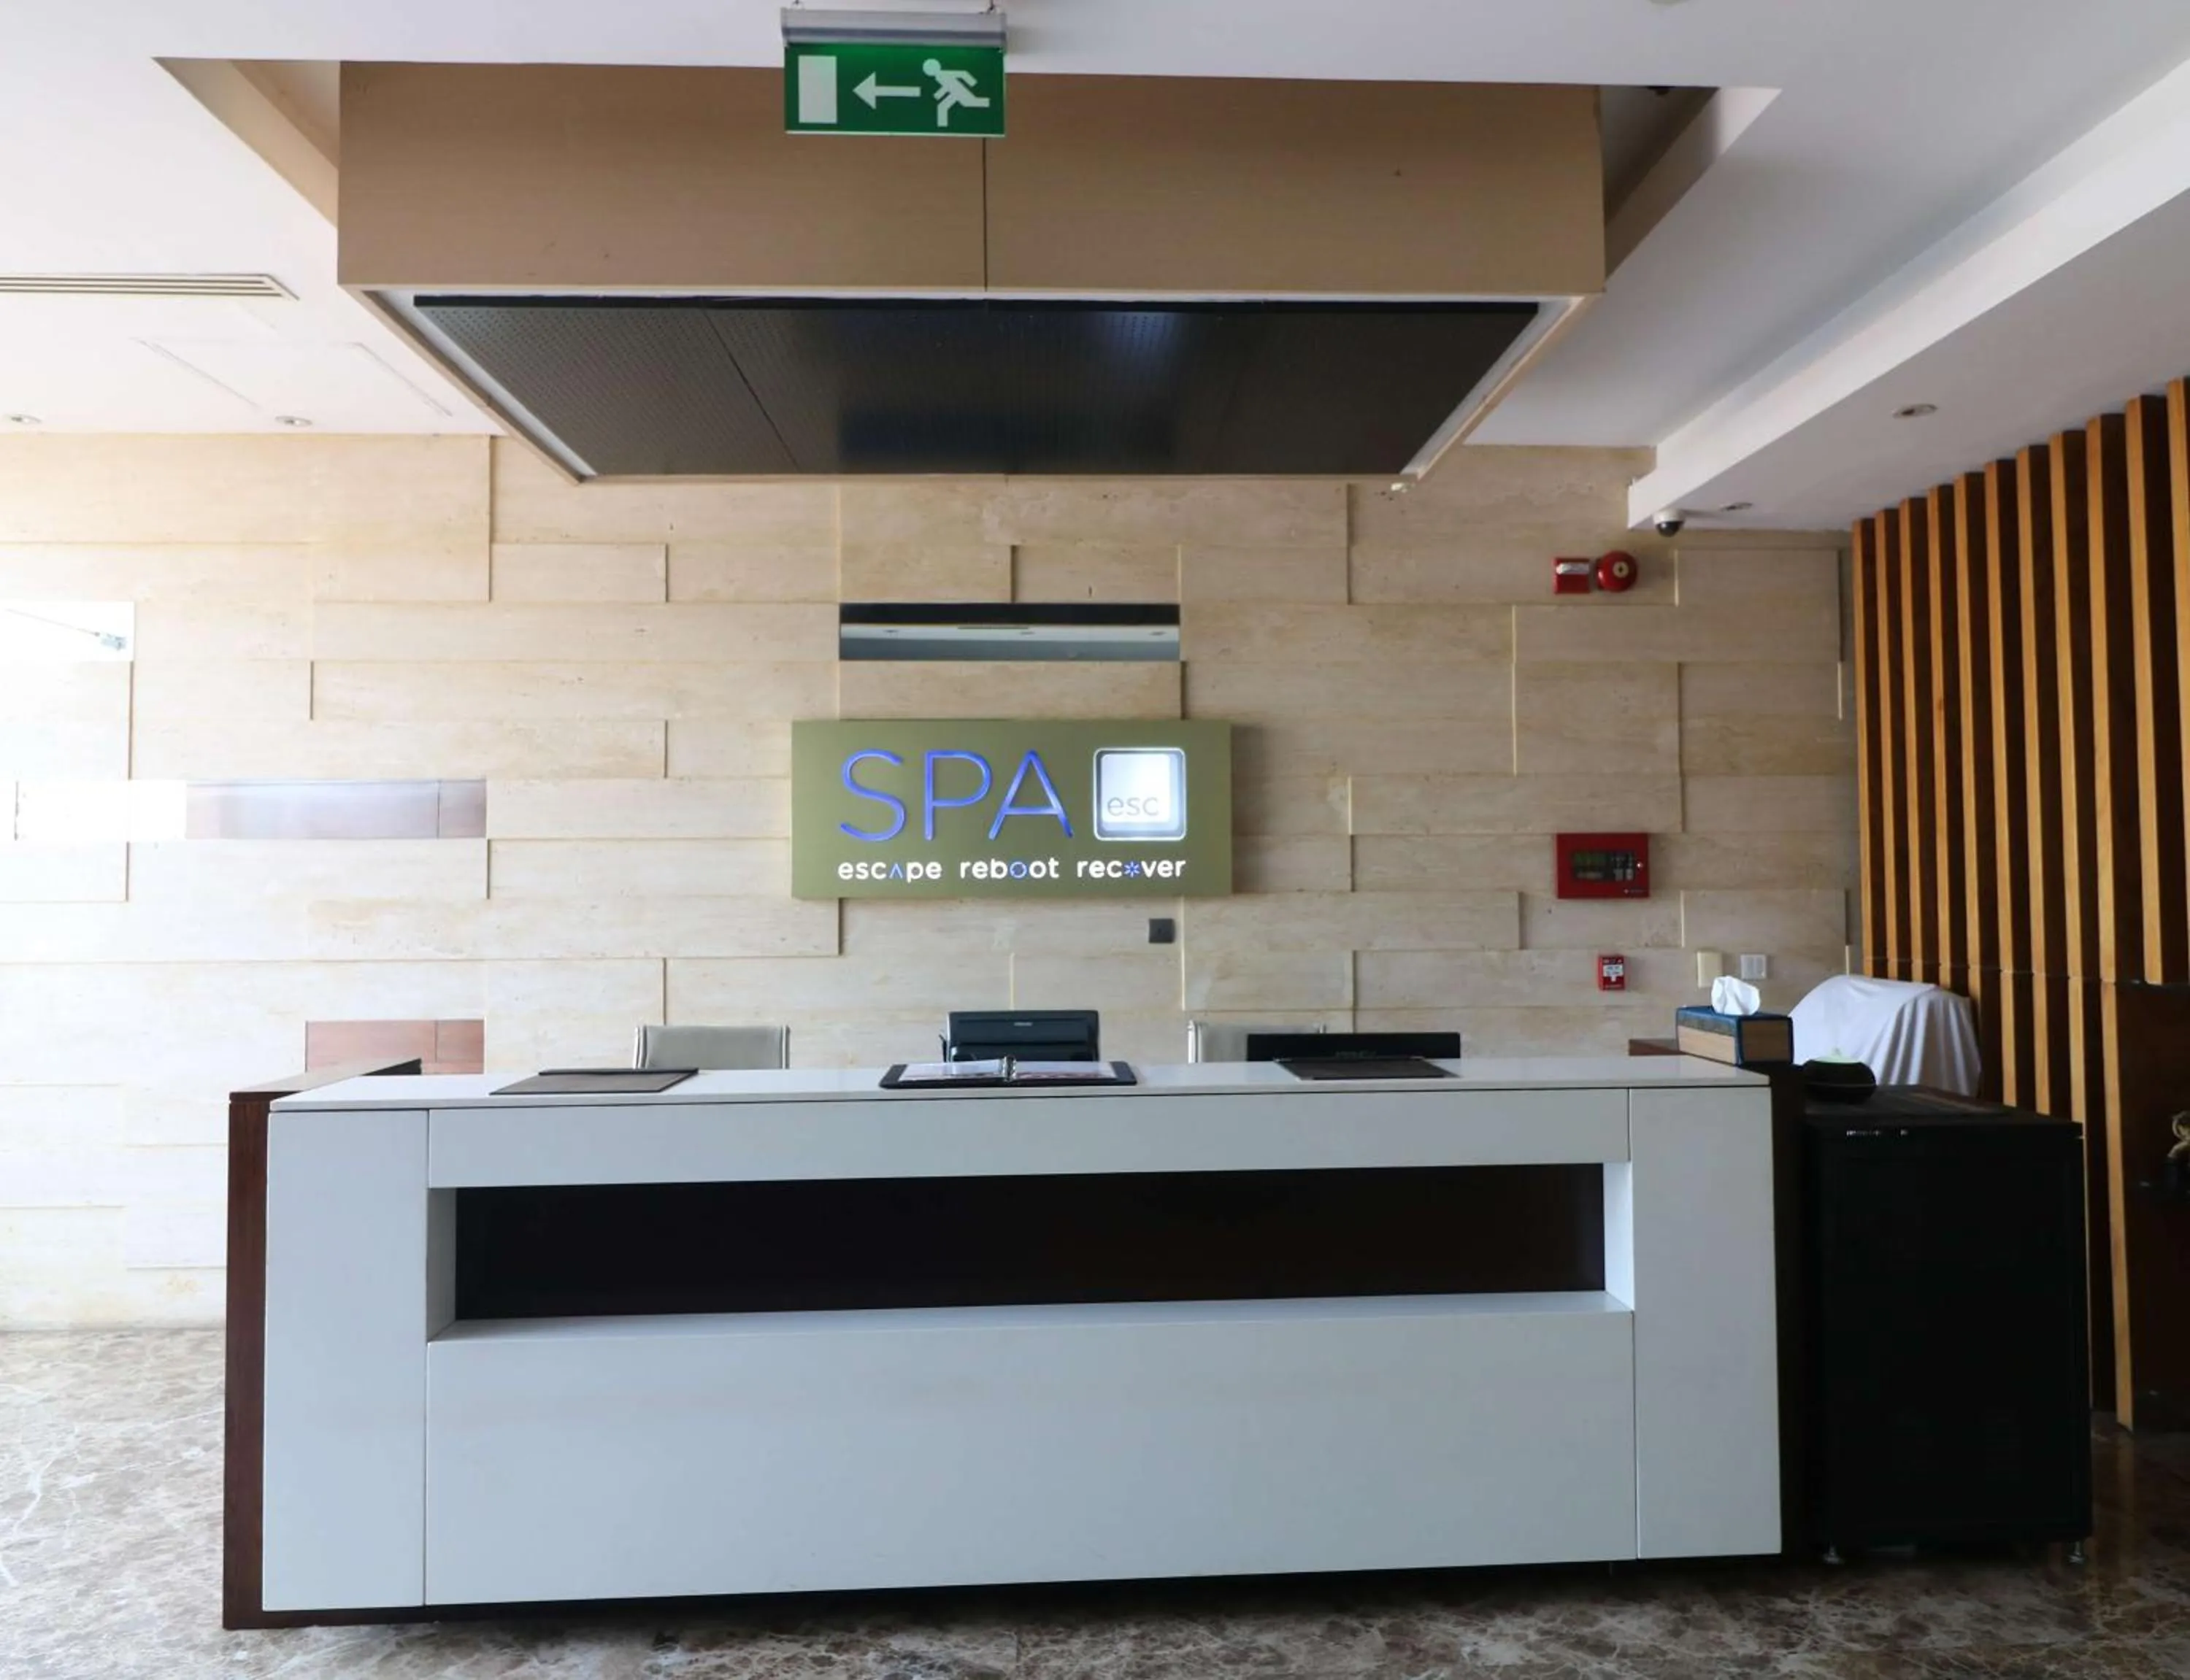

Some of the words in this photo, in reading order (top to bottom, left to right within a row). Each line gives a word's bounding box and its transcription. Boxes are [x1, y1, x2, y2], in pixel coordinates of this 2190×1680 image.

[840, 748, 1074, 841] SPA
[1107, 795, 1159, 817] esc
[960, 858, 1059, 879] reboot
